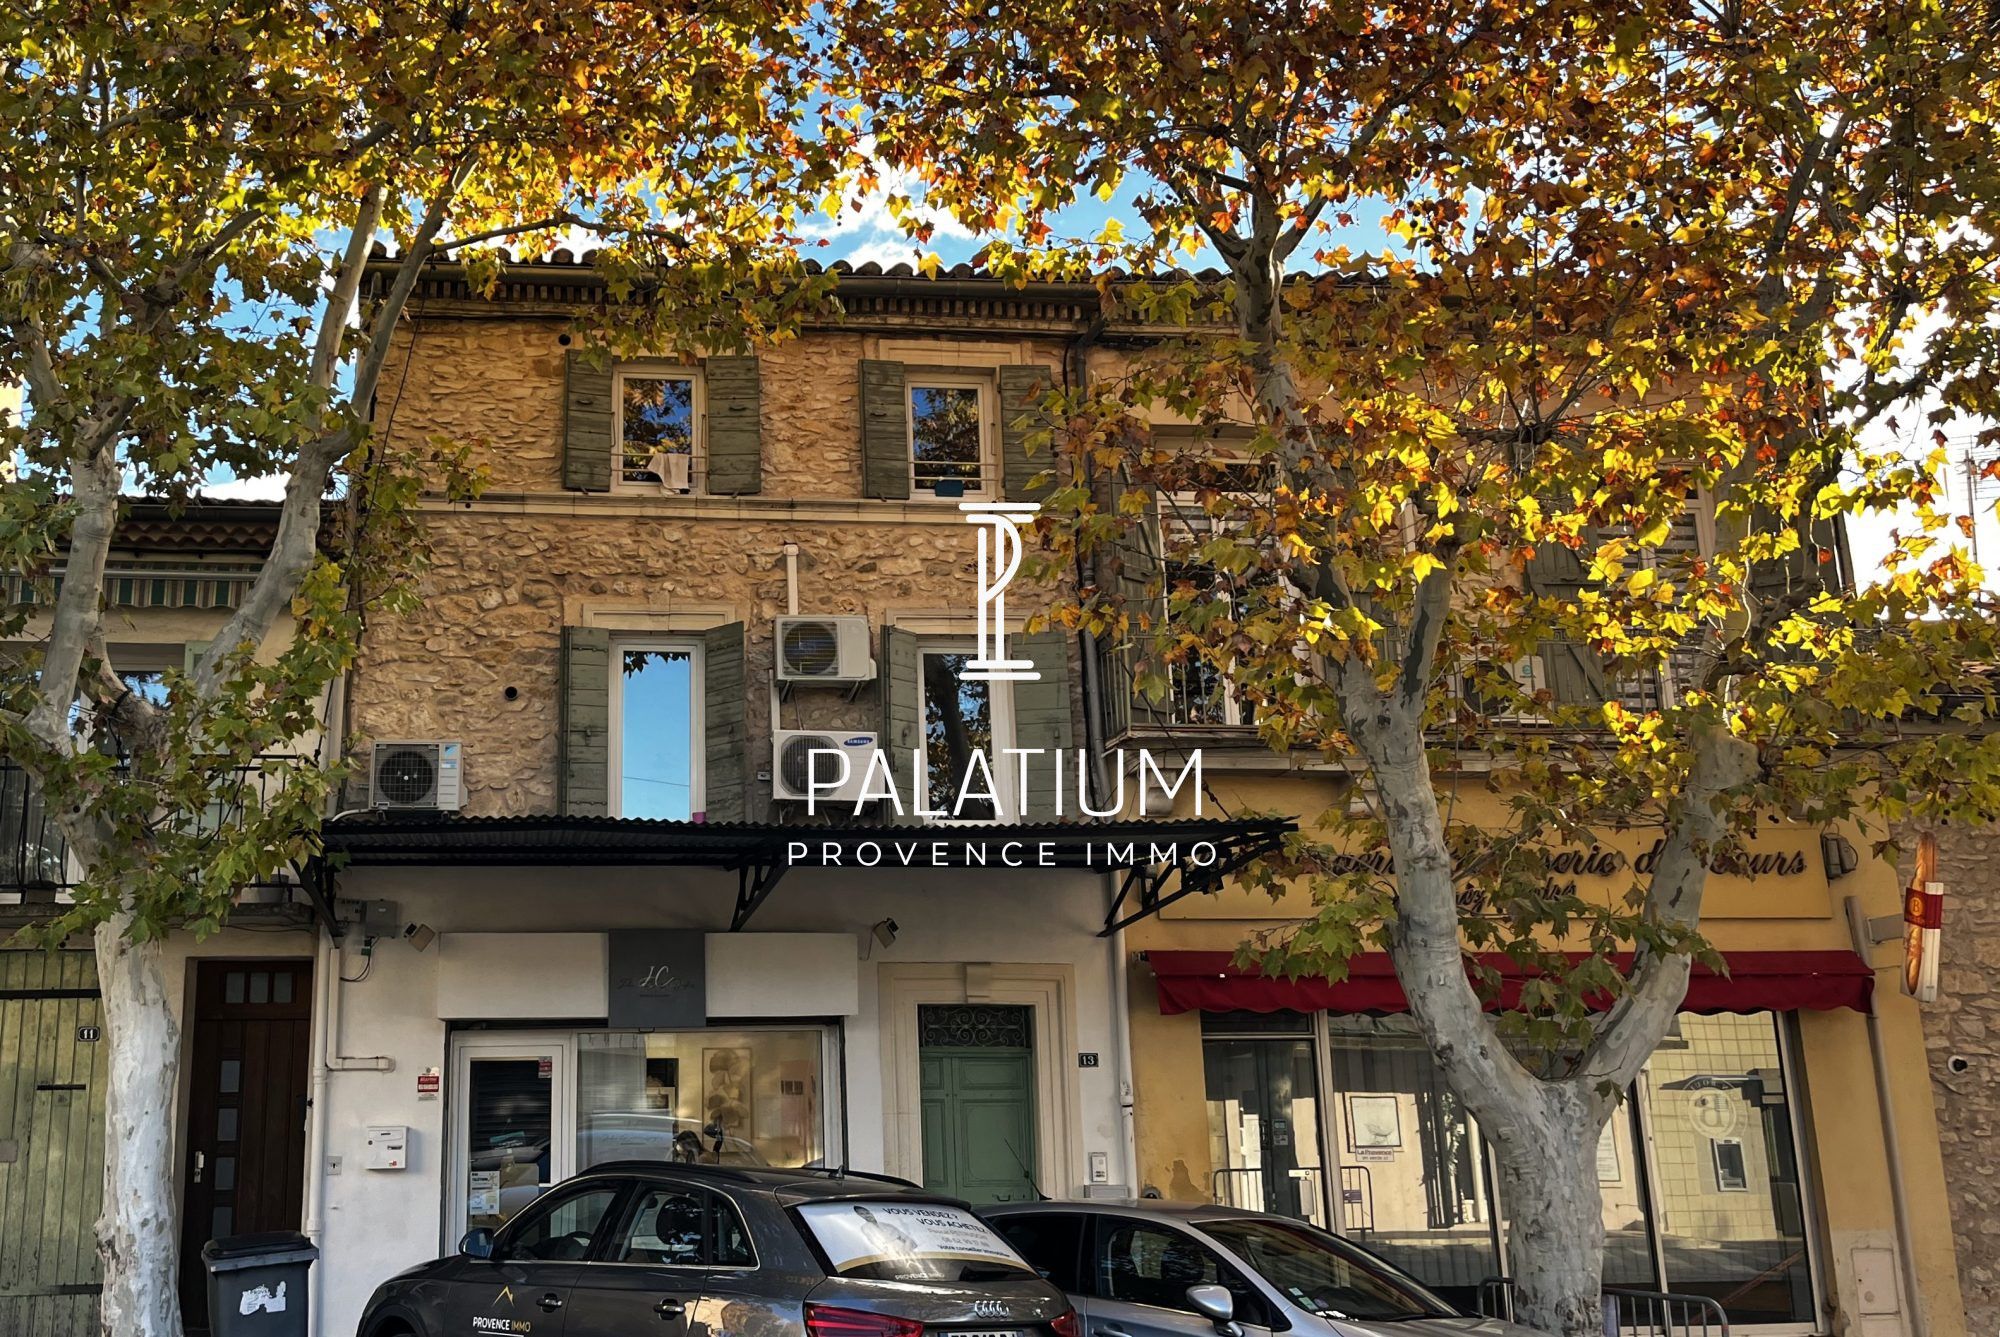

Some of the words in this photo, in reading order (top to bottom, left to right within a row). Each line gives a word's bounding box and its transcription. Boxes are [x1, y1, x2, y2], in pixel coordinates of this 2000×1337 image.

[83, 1028, 94, 1039] 11
[1082, 1055, 1095, 1065] 13
[883, 1207, 915, 1216] VOUS
[916, 1209, 954, 1220] VENDEZ
[916, 1217, 946, 1227] VOUS
[947, 1221, 987, 1234] ACHETEZ
[472, 1316, 511, 1331] PROVENCE
[511, 1320, 531, 1333] IMMO
